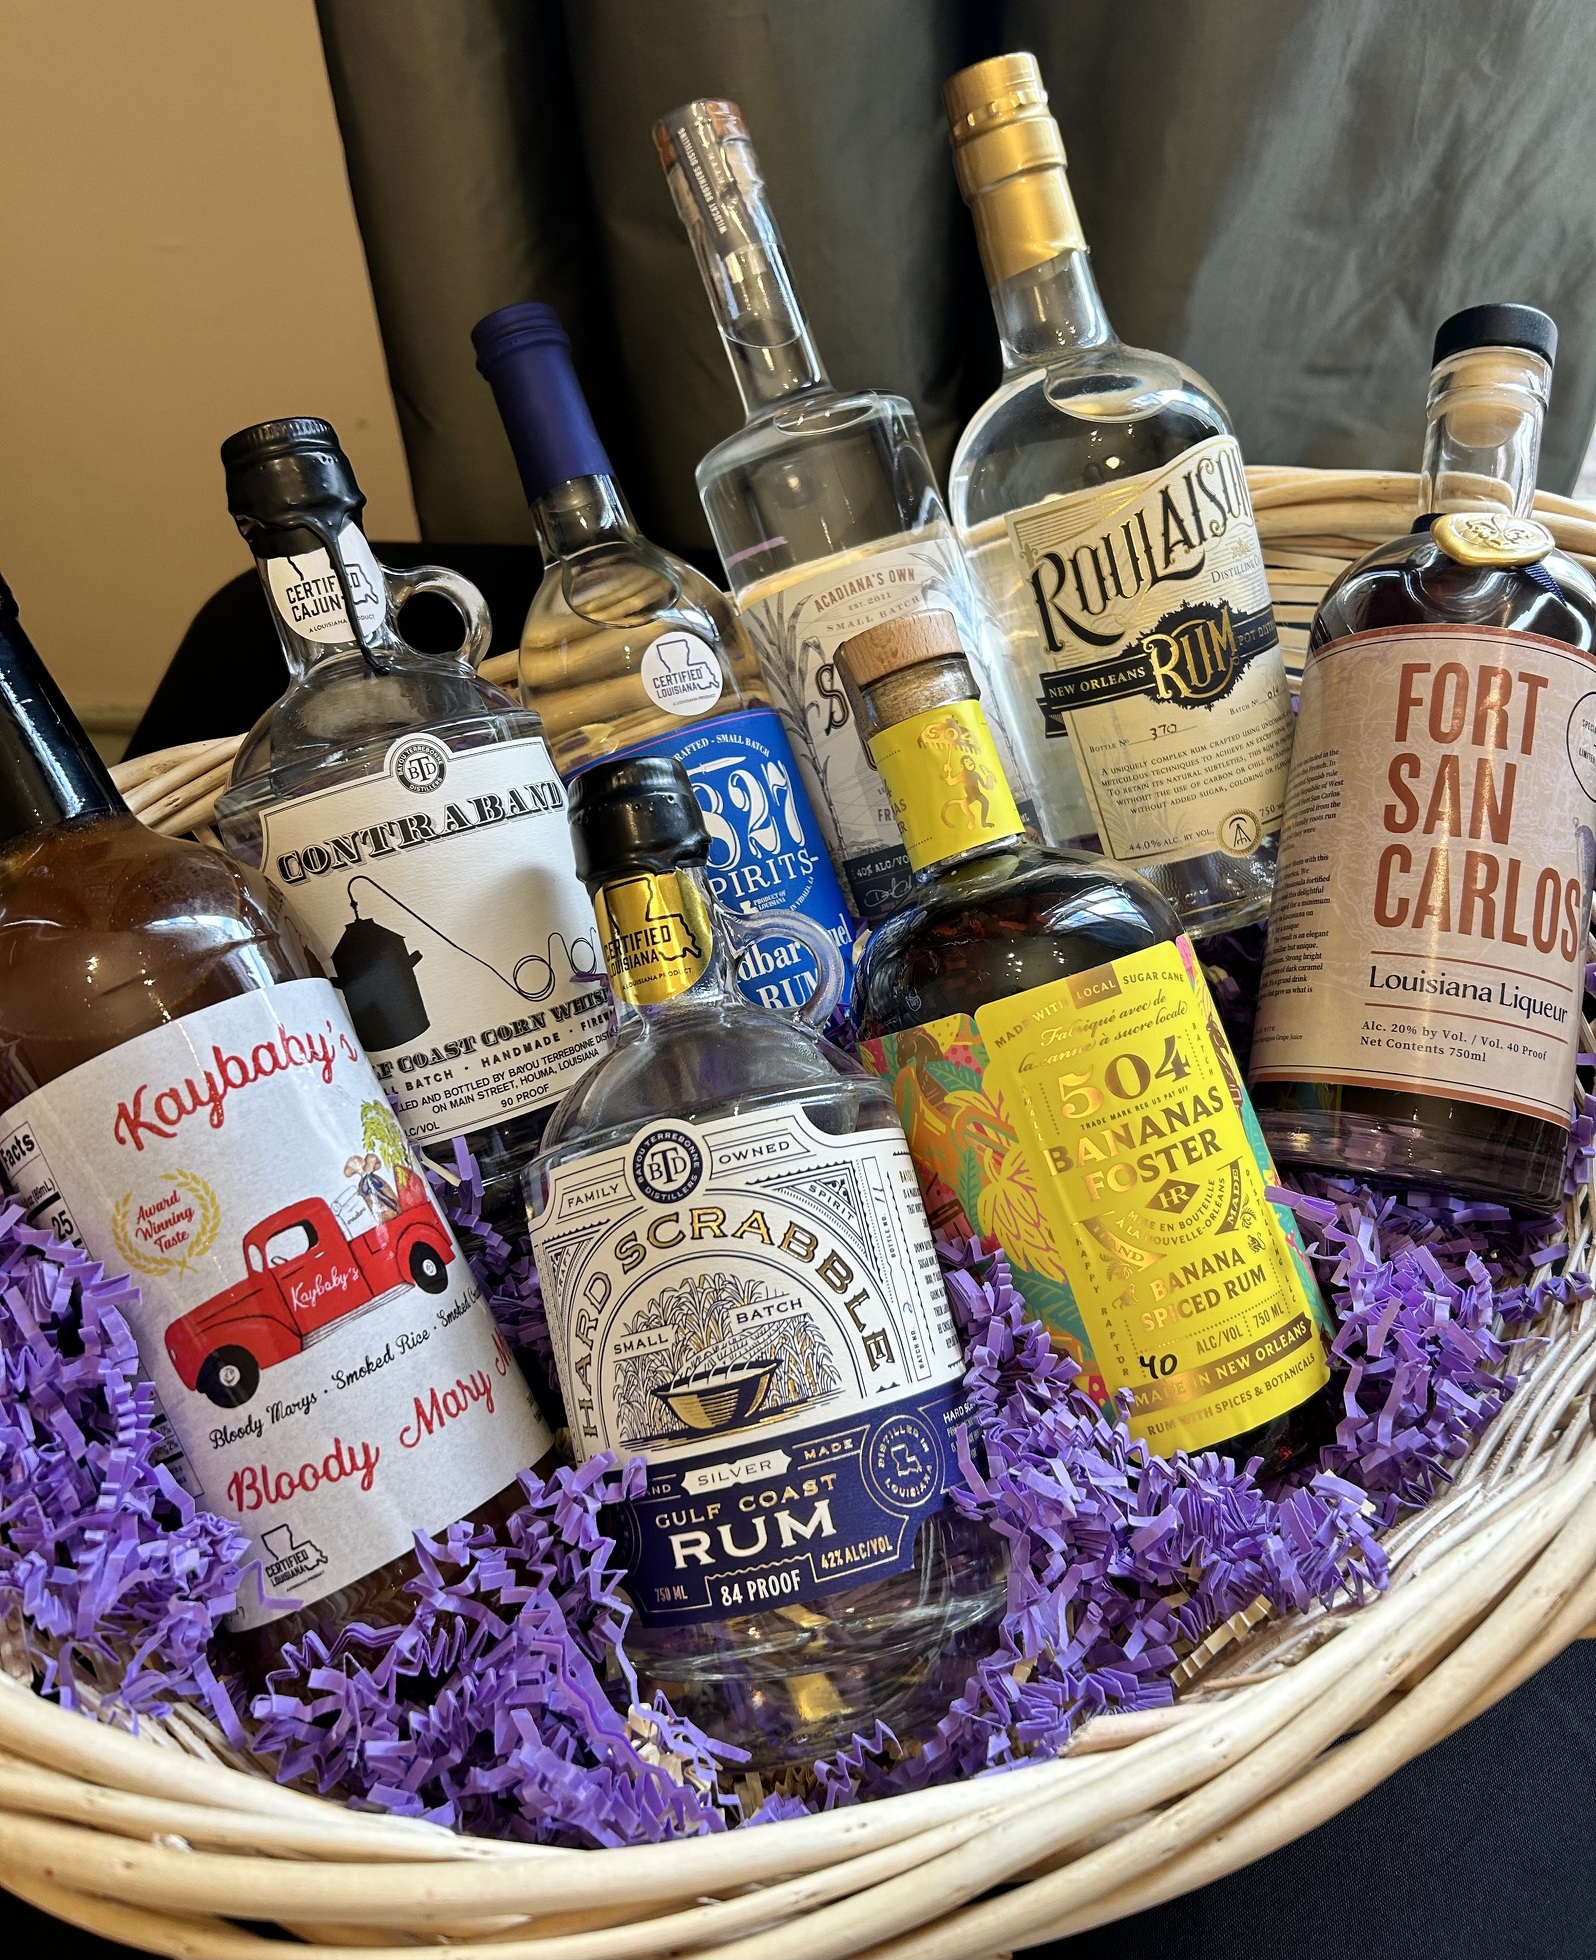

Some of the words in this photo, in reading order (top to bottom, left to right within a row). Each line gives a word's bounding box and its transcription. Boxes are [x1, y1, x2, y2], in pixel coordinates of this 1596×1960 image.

[693, 166, 714, 206] BROTHERS
[708, 202, 728, 235] WILDCAT
[286, 572, 361, 604] CERTIFD
[814, 572, 884, 613] ACADIANA'S
[889, 567, 916, 584] OWN
[866, 592, 892, 605] 2011
[292, 594, 342, 622] CAJUN
[826, 616, 874, 632] SMALL
[880, 596, 920, 618] BATCH
[1142, 606, 1240, 700] RUM
[652, 668, 704, 689] CERTIFIED
[656, 682, 698, 699] LOUISIANA
[1048, 683, 1077, 699] NEW
[1079, 667, 1146, 692] ORLEANS
[1394, 661, 1549, 756] FORT
[716, 734, 744, 744] SMALL
[745, 737, 770, 758] BATCH
[1090, 743, 1116, 753] BOTTLE
[1149, 723, 1177, 740] 370
[1101, 772, 1150, 788] METICULOUS
[1150, 759, 1200, 776] TECHNIQUES
[1215, 744, 1244, 759] ACHIEVE
[1110, 760, 1148, 774] UNIQUELY
[1150, 750, 1188, 766] COMPLEX
[1190, 745, 1208, 754] RUM
[1209, 734, 1241, 748] CRAFTED
[1116, 794, 1152, 808] WITHOUT
[1156, 789, 1171, 799] THE
[1203, 770, 1234, 786] CARBON
[1123, 782, 1150, 794] RETAIN
[1166, 770, 1202, 784] NATURAL
[1326, 770, 1338, 778] rule
[1328, 779, 1344, 788] West
[1130, 801, 1168, 815] WITHOUT
[1170, 794, 1198, 806] ADDED
[1229, 772, 1264, 790] COLORING
[1258, 804, 1276, 817] 750
[1320, 790, 1340, 800] Carlos
[1383, 752, 1516, 846] SAN
[693, 760, 806, 871] 827
[276, 781, 565, 888] CONTRABAND
[1129, 838, 1162, 852] 44.0%
[709, 848, 814, 902] PIRITS
[1297, 886, 1324, 898] delightful
[1306, 874, 1330, 884] fortified
[753, 892, 778, 906] PRODUCT
[758, 898, 786, 910] LOUISIANA
[1301, 898, 1330, 907] minimum
[1373, 844, 1581, 964] CARLOS
[604, 924, 672, 962] CERTIFIED
[1306, 930, 1329, 940] elegant
[608, 948, 660, 978] LOUISIANA
[1298, 962, 1323, 972] caramel
[1302, 952, 1322, 962] bright
[995, 1020, 1031, 1048] MADE
[1032, 997, 1070, 1022] WITH
[1076, 980, 1116, 1000] LOCAL
[1123, 972, 1159, 985] SUGAR
[1162, 972, 1184, 983] CANE
[1118, 1002, 1150, 1019] avec
[1152, 988, 1167, 1006] de
[1369, 965, 1492, 1003] Louisiana
[1499, 982, 1568, 1024] Liqueur
[398, 1034, 477, 1074] COAST
[480, 1010, 548, 1047] CORN
[1040, 1038, 1096, 1066] canne
[1114, 1020, 1154, 1041] sucre
[1155, 1000, 1188, 1025] locale
[1192, 1022, 1214, 1076] BATCH
[1360, 1036, 1382, 1047] Net
[1386, 1038, 1445, 1055] Contents
[1448, 1047, 1486, 1062] 750ml
[1361, 1020, 1386, 1032] Alc.
[1390, 1023, 1418, 1035] 20%
[1422, 1026, 1438, 1040] by
[1442, 1030, 1468, 1042] Vol.
[1480, 1036, 1504, 1050] Vol.
[1506, 1043, 1519, 1053] 40
[1522, 1045, 1548, 1061] Proof
[404, 1068, 455, 1092] BATCH
[481, 1032, 561, 1068] HANDMADE
[421, 1092, 442, 1108] AND
[444, 1077, 490, 1100] BOTTLED
[492, 1071, 506, 1084] BY
[508, 1060, 540, 1078] BAYOU
[540, 1038, 596, 1068] TERREBONNE
[1058, 1034, 1192, 1119] 504
[114, 1020, 359, 1152] Kaybaby's
[432, 1103, 448, 1115] ON
[450, 1094, 476, 1110] MAIN
[477, 1080, 520, 1105] STREET,
[520, 1066, 558, 1086] HOUMA,
[559, 1048, 600, 1072] LOUISIANA
[500, 1097, 514, 1108] 90
[516, 1084, 550, 1104] PROOF
[1044, 1085, 1224, 1176] BANANAS
[1080, 1117, 1107, 1131] TRADE
[1110, 1108, 1132, 1120] MARK
[644, 1132, 700, 1168] TERREBONNE
[718, 1140, 790, 1166] OWNED
[1082, 1128, 1223, 1202] FOSTER
[567, 1182, 620, 1209] FAMILY
[645, 1174, 698, 1200] DISTILLERS
[808, 1184, 856, 1223] SPIRIT
[1160, 1223, 1175, 1232] EN
[1178, 1178, 1216, 1230] BOUTEILLE
[52, 1210, 74, 1240] 25
[135, 1206, 195, 1242] Winning
[136, 1190, 181, 1225] Award
[1144, 1178, 1226, 1246] NOUVELLE-ORLÉANS
[154, 1230, 190, 1254] Taste
[290, 1266, 360, 1312] Kaybaby's
[556, 1250, 572, 1299] CRAFT
[1150, 1246, 1246, 1302] BANANA
[736, 1298, 804, 1325] BATCH
[1140, 1288, 1222, 1332] SPICED
[1224, 1264, 1268, 1300] RUM
[574, 1270, 613, 1438] HARD
[614, 1206, 896, 1372] SCRABBLE
[1196, 1324, 1244, 1355] ALC/VOL
[1253, 1310, 1270, 1329] 750
[1271, 1304, 1285, 1318] ML
[613, 1333, 670, 1356] SMALL
[209, 1418, 264, 1450] Bloody
[265, 1392, 318, 1425] Marys
[331, 1343, 396, 1390] Smoked
[396, 1328, 430, 1354] Rice
[436, 1292, 472, 1328] Smoked
[1134, 1380, 1188, 1408] MADE
[1216, 1354, 1251, 1380] NEW
[1255, 1320, 1308, 1362] ORLEANS
[1140, 1353, 1178, 1380] 40
[1147, 1420, 1176, 1436] RUM
[1215, 1390, 1253, 1414] SPICES
[1265, 1353, 1316, 1392] BOTANICALS
[227, 1436, 380, 1513] Bloody
[399, 1368, 495, 1450] Mary
[803, 1438, 854, 1461] MADE
[876, 1424, 920, 1469] DISTILLED
[698, 1460, 772, 1487] SILVER
[883, 1464, 934, 1498] LOUISIANA
[656, 1502, 722, 1529] GULF
[738, 1473, 837, 1512] COAST
[668, 1498, 837, 1570] RUM
[820, 1548, 844, 1570] 42%
[844, 1534, 894, 1564] ALC/VOL
[264, 1548, 310, 1578] CERTIFIED
[270, 1564, 307, 1588] LOUISIANA
[654, 1586, 672, 1603] 750
[672, 1584, 688, 1600] ML
[720, 1582, 744, 1607] 84
[746, 1568, 800, 1602] PROOF
